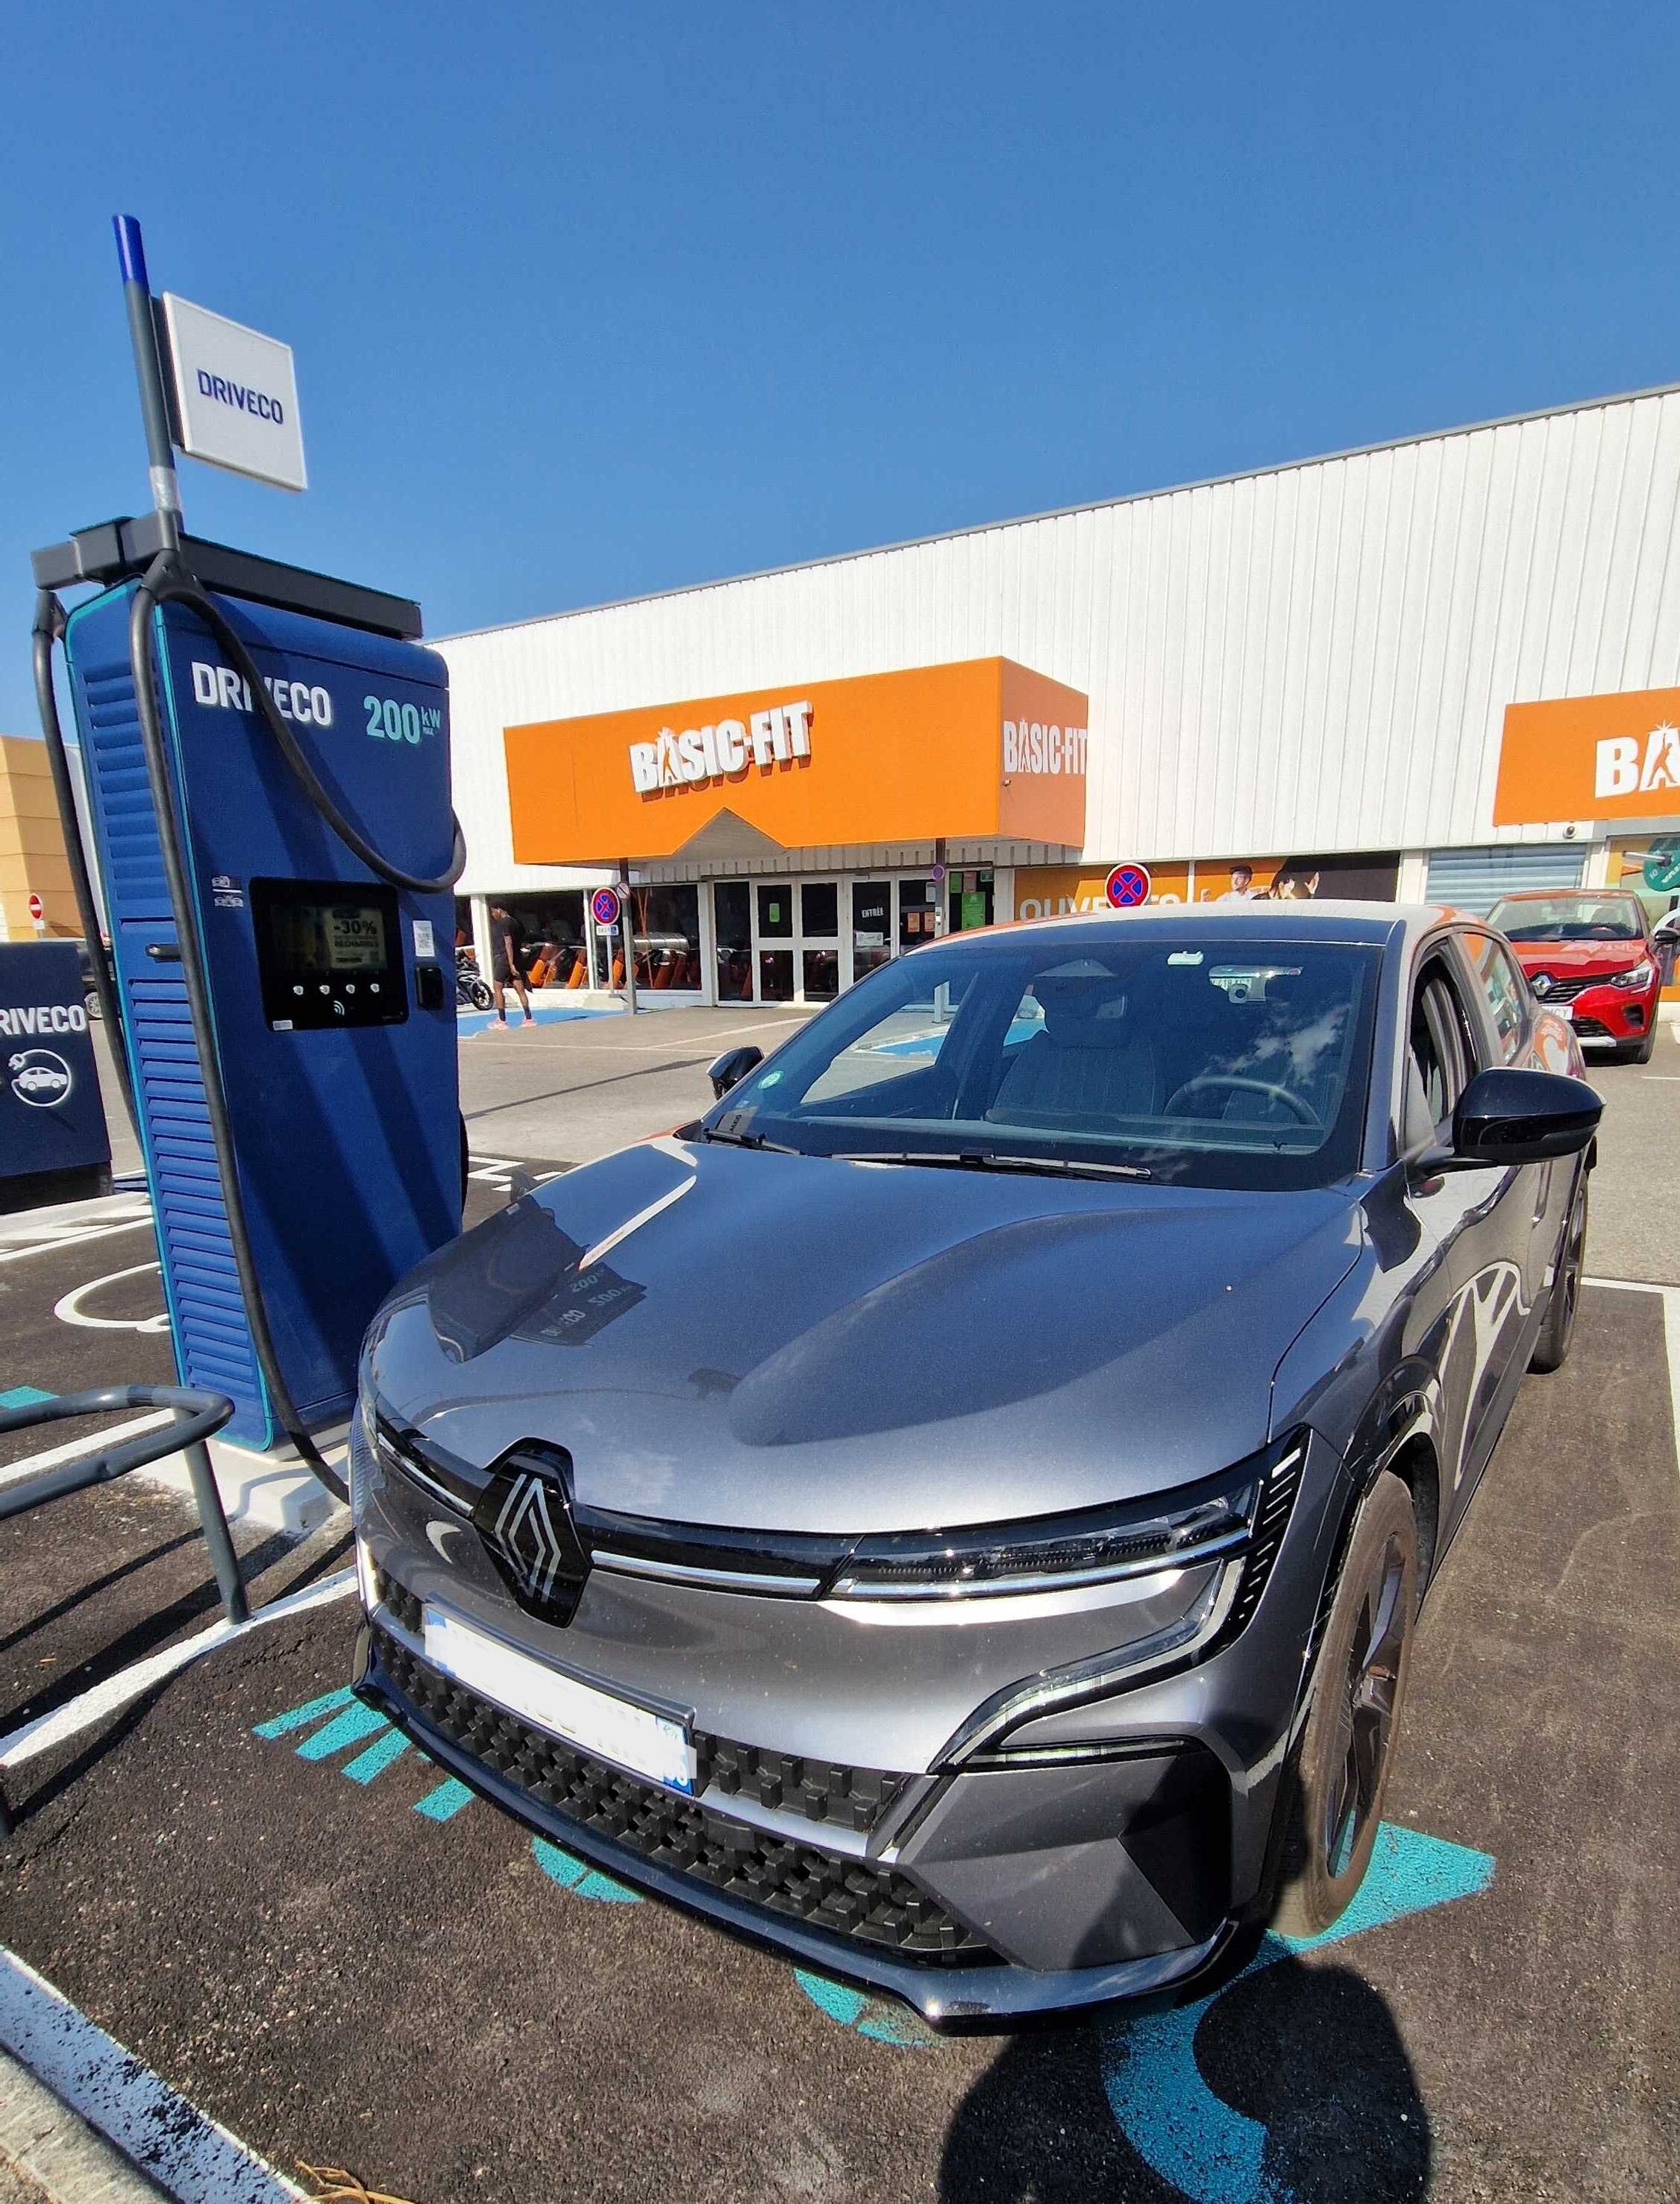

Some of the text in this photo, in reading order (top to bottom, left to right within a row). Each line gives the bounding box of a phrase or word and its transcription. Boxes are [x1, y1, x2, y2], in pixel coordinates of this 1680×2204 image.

[197, 369, 283, 425] DRIVECO
[191, 661, 333, 727] DRIECO
[364, 695, 440, 744] 200 kW
[630, 701, 813, 793] BASIC-FIT
[1003, 719, 1088, 774] BASIC-FIT
